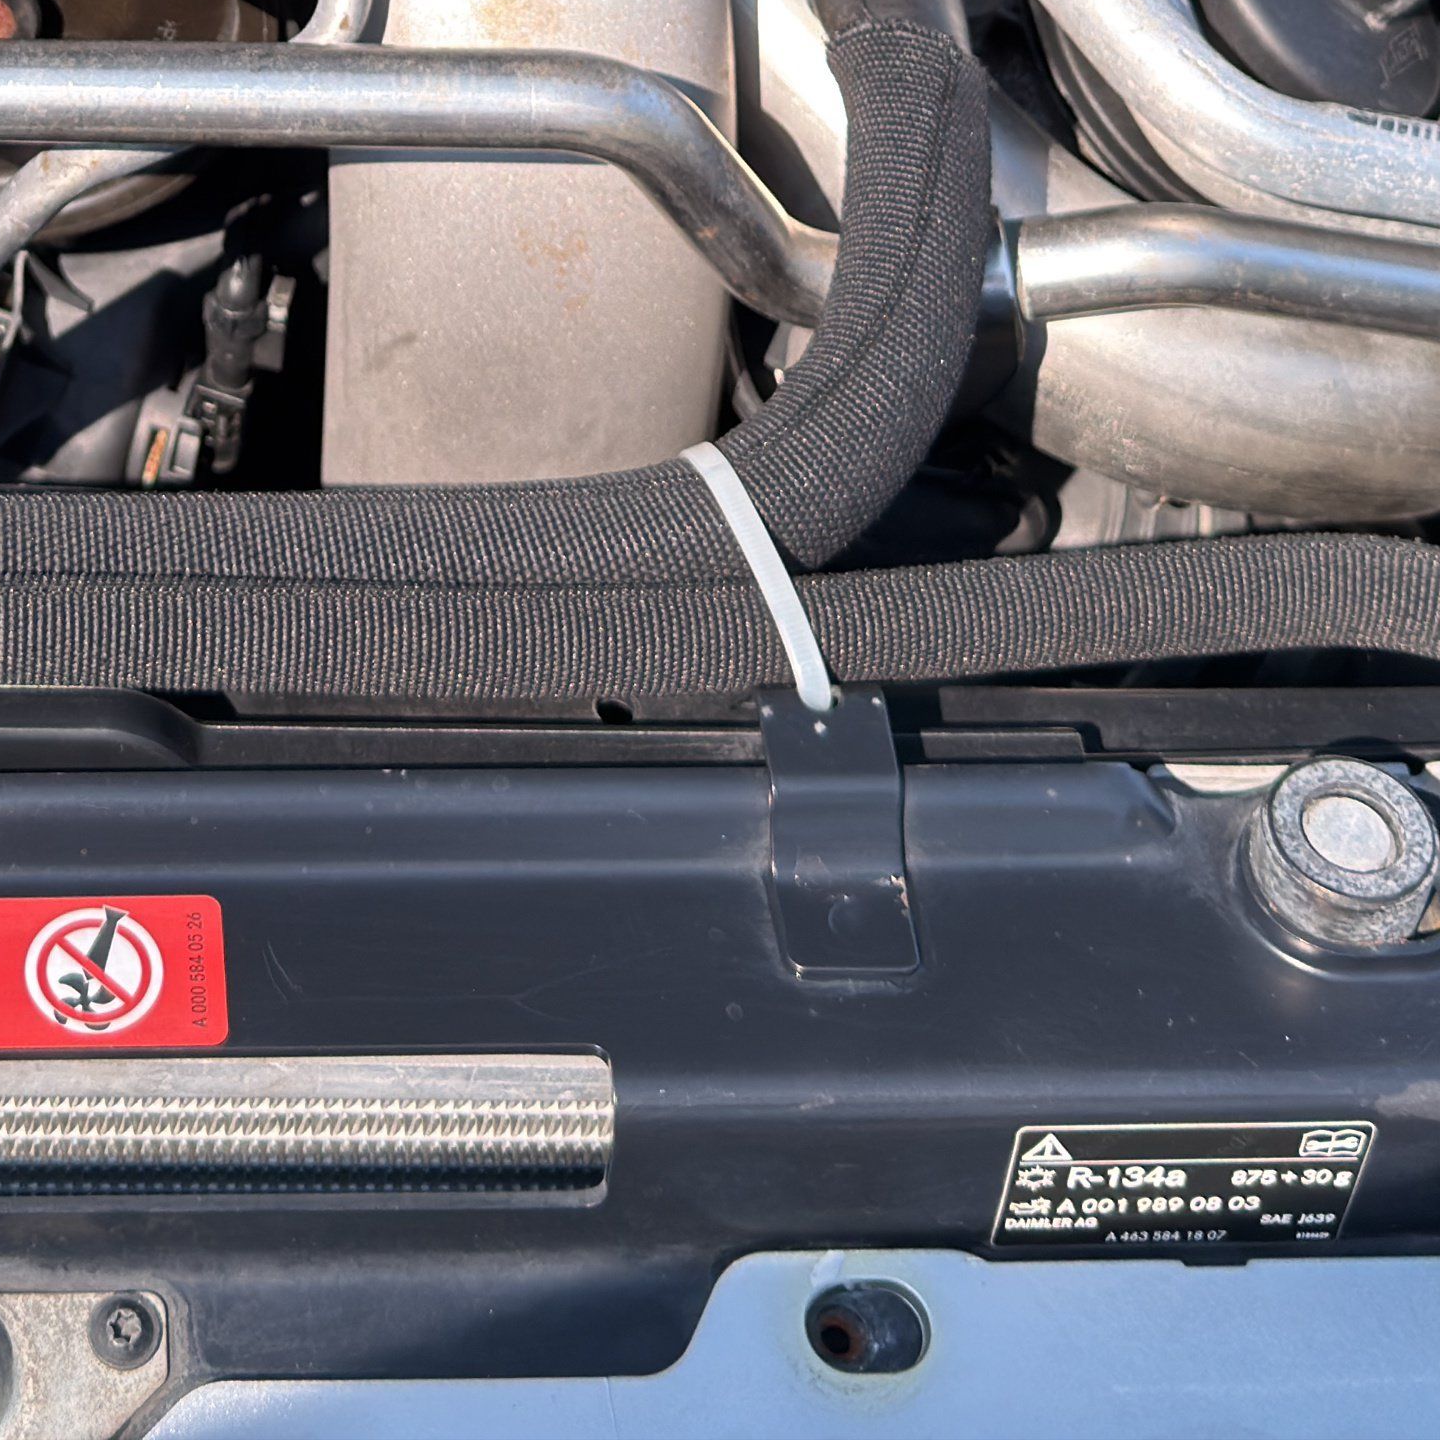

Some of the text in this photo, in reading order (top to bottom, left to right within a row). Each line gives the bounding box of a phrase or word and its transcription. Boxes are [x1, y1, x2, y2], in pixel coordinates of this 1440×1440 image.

[186, 911, 207, 1028] A 000 584 05 26
[1066, 1167, 1187, 1189] R-134a
[1230, 1170, 1275, 1187] 875
[1300, 1169, 1332, 1185] 30
[1333, 1170, 1353, 1188] g
[1056, 1196, 1262, 1215] A 001 989 08 03
[1004, 1217, 1099, 1230] DAIMLER AG
[1260, 1212, 1336, 1225] SAE J639
[1105, 1229, 1227, 1243] A 463 584 18 07
